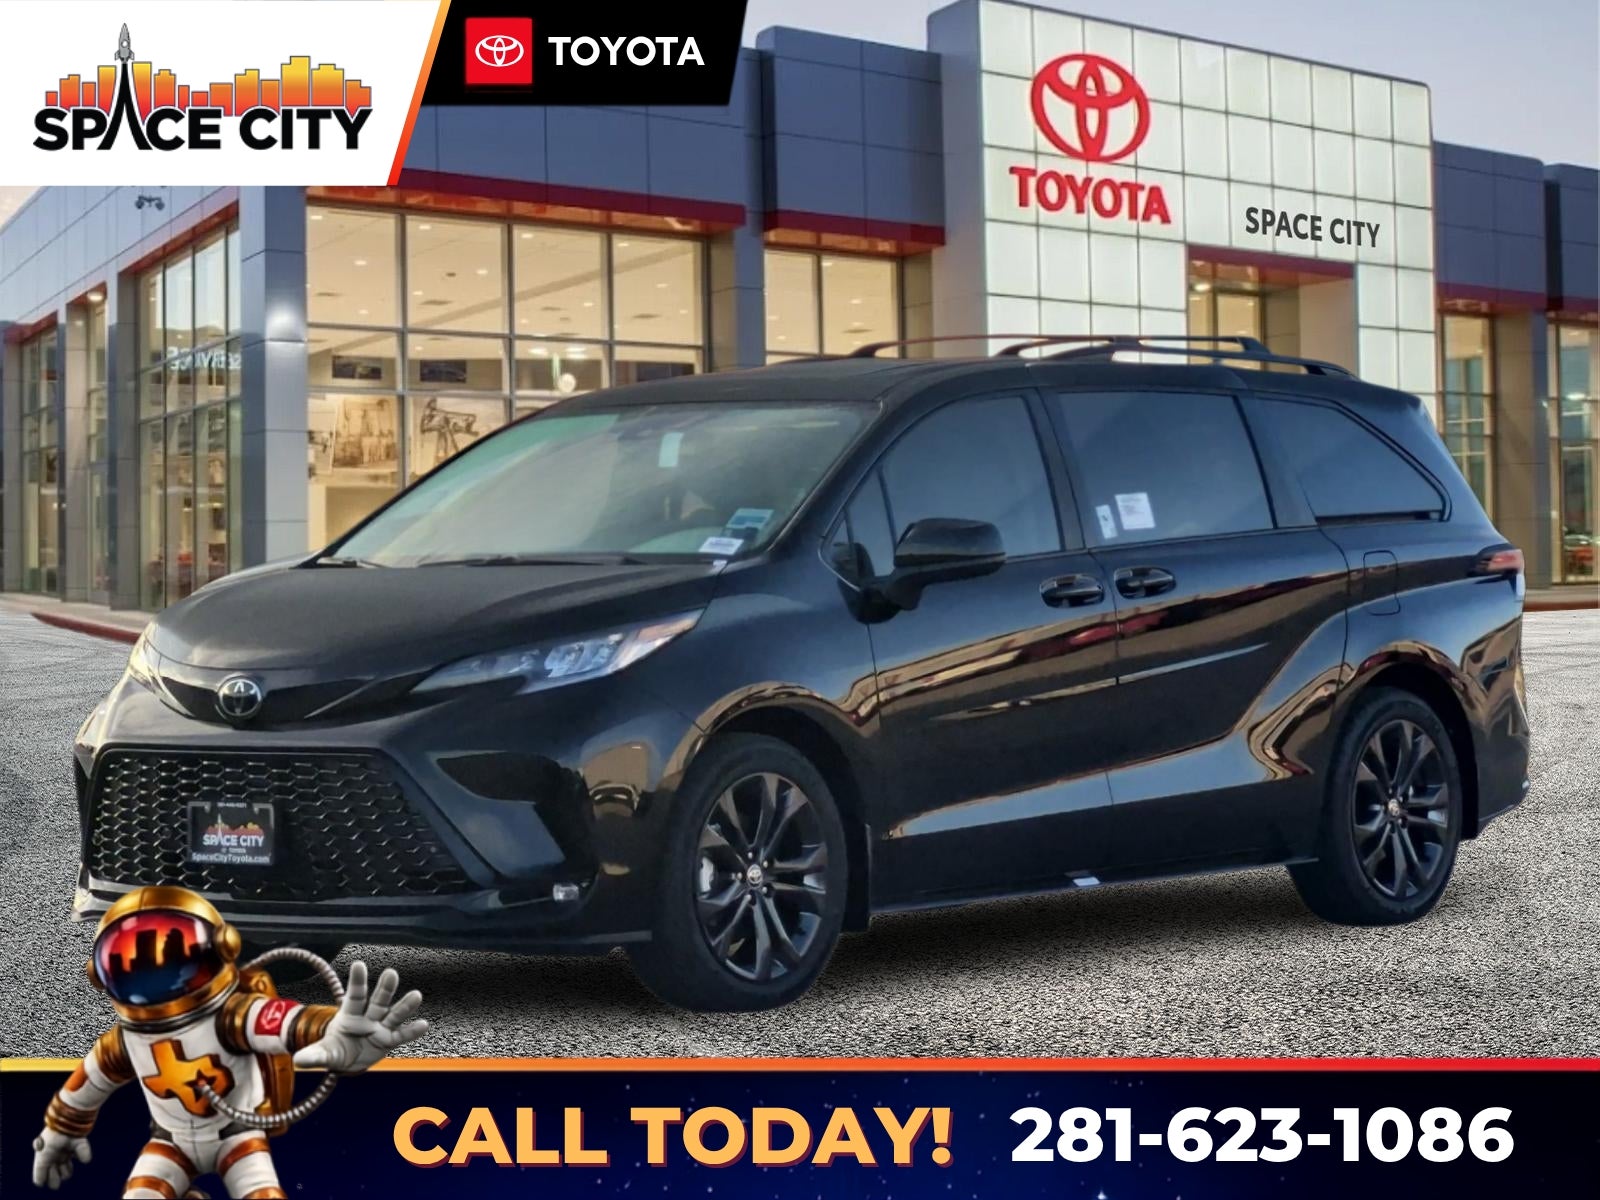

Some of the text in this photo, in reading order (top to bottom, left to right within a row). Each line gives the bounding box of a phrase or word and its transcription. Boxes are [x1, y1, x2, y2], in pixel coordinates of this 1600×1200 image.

[1009, 165, 1171, 225] TOYOTA
[1245, 206, 1381, 248] SPACE CITY
[202, 832, 265, 847] SPACE CITY
